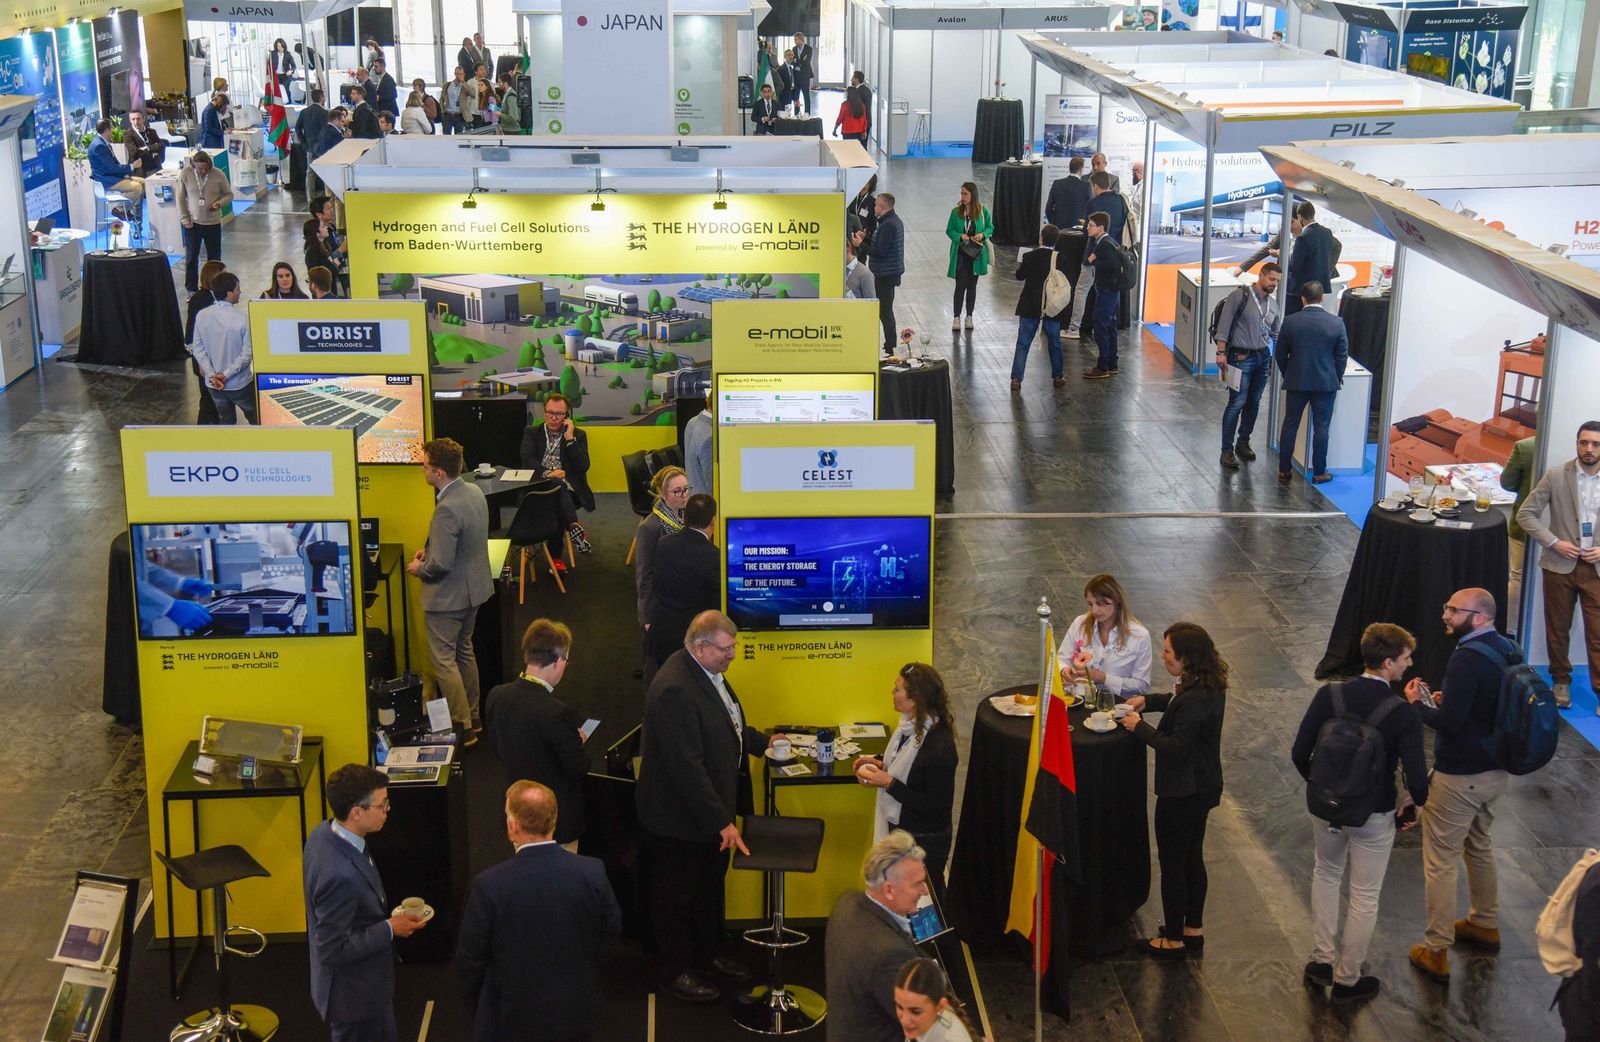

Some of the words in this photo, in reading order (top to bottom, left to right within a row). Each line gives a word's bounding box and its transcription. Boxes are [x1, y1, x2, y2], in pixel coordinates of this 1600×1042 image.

[229, 7, 274, 16] JAPAN
[600, 14, 662, 30] JAPAN
[1116, 111, 1147, 124] Swag
[1330, 122, 1395, 137] PILZ
[1172, 156, 1217, 168] Hydrog
[1221, 155, 1262, 165] solutions
[1166, 176, 1176, 185] H2
[1228, 186, 1265, 200] Hydrogen
[372, 221, 437, 234] Hydrogen
[442, 222, 466, 232] and
[470, 222, 496, 232] Fuel
[500, 222, 525, 233] Cell
[529, 222, 590, 233] Solutions
[652, 222, 682, 234] THE
[687, 222, 773, 234] HYDROGEN
[778, 219, 820, 234] LÄND
[374, 239, 404, 250] from
[408, 240, 542, 253] Baden-Württemberg
[729, 243, 737, 251] by
[742, 240, 807, 250] e-mobil
[306, 326, 372, 340] OBRIST
[748, 326, 827, 339] e-mobil
[169, 466, 240, 482] EKPO
[802, 470, 853, 480] CELEST
[828, 641, 852, 650] LÄND
[254, 650, 278, 659] LÄND
